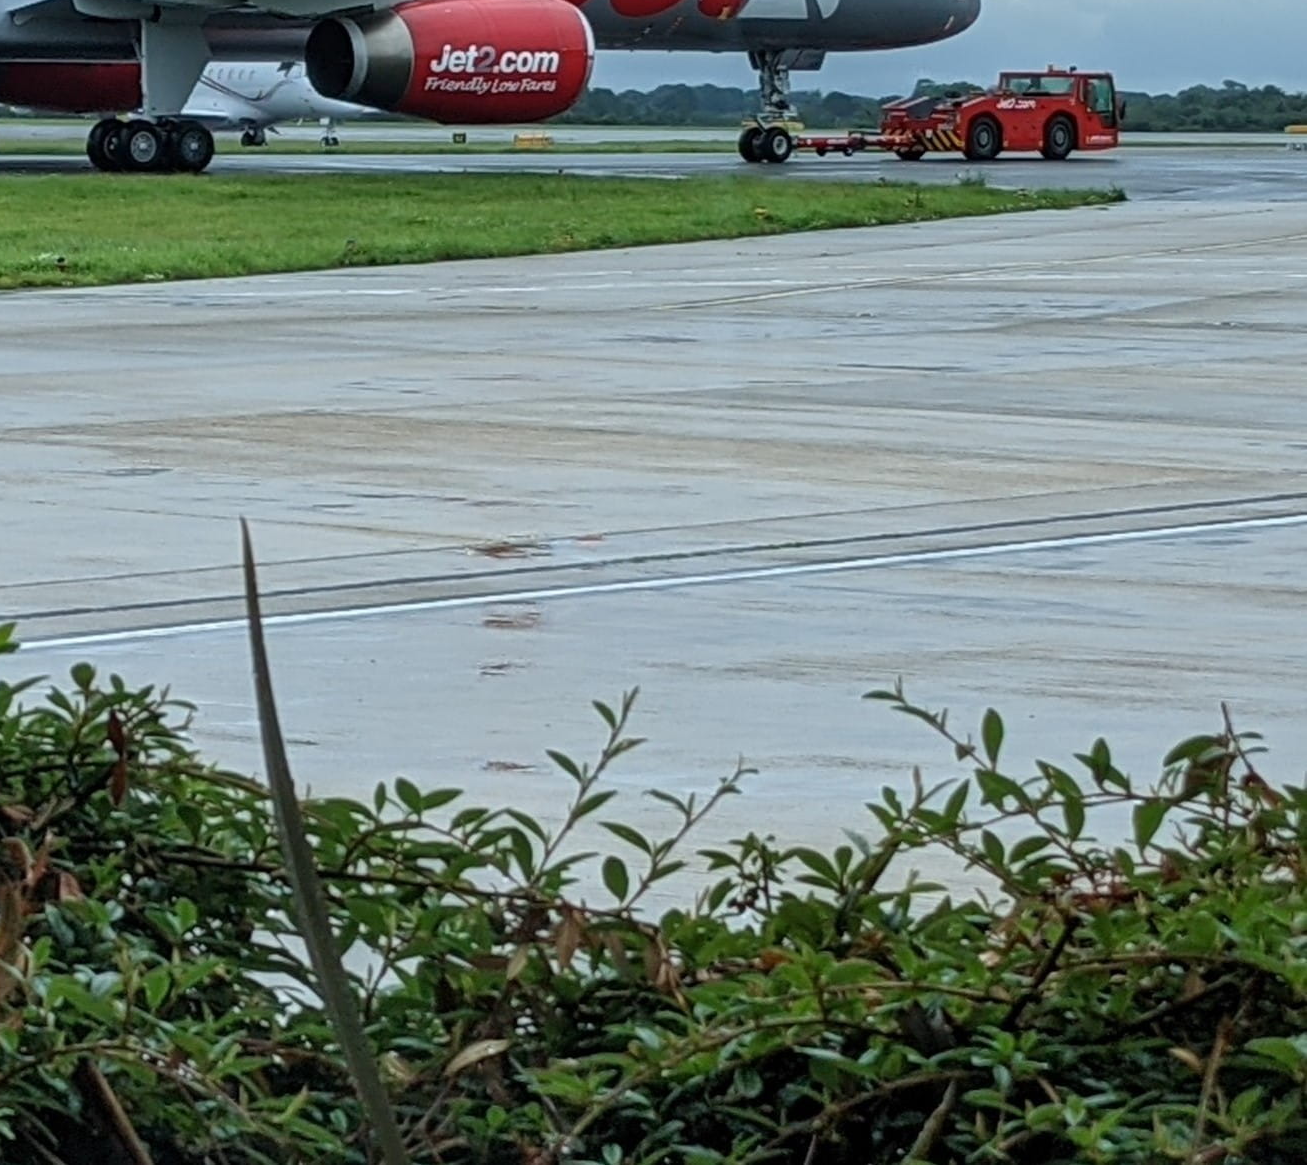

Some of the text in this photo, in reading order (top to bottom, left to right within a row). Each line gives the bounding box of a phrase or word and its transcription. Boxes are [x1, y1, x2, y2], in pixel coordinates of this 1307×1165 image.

[424, 77, 557, 95] Friendly Low Fares
